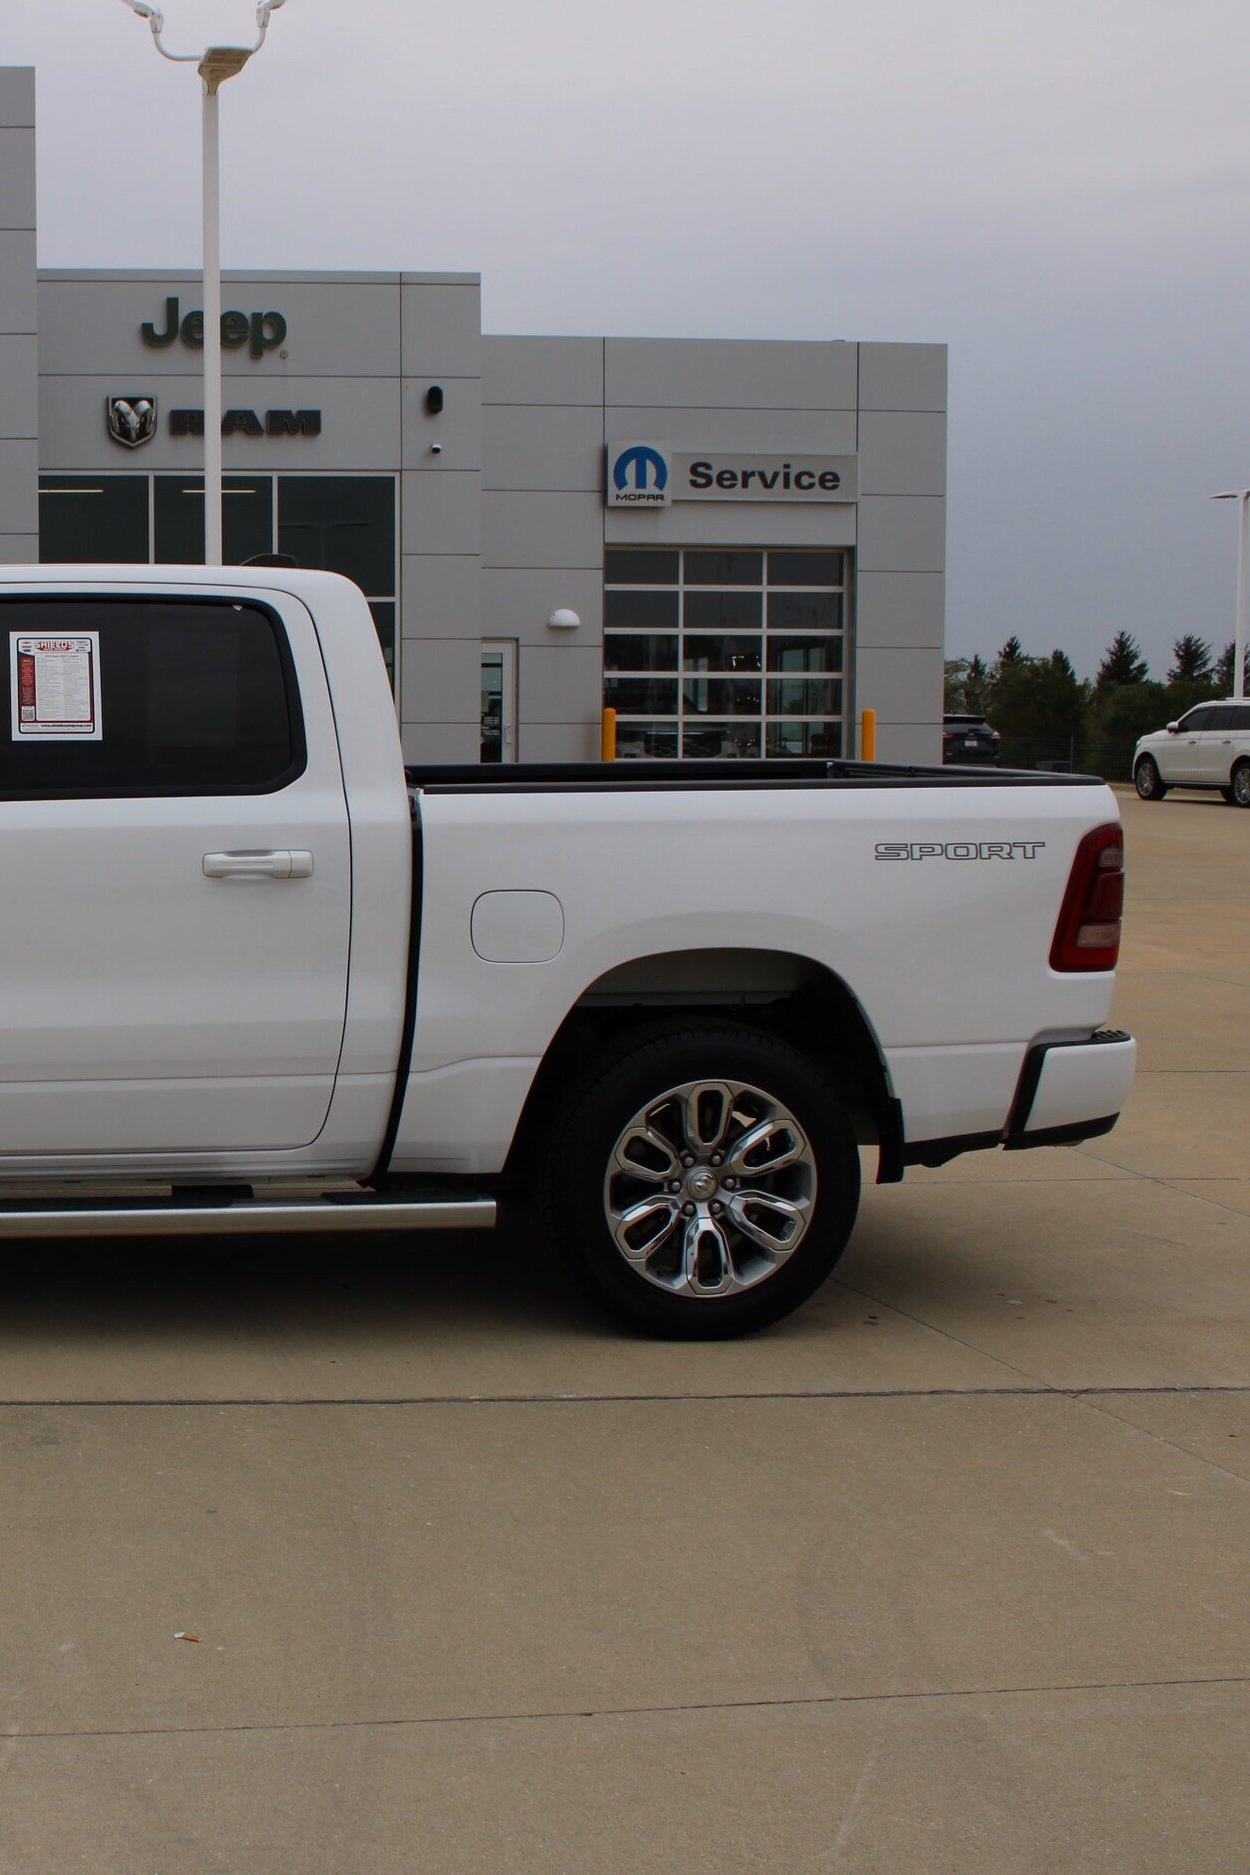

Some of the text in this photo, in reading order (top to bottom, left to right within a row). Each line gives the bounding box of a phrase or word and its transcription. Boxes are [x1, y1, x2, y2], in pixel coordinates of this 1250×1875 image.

[141, 297, 288, 358] Jeep
[169, 410, 322, 436] RAM
[689, 461, 841, 491] Service
[615, 493, 665, 501] MOPAR
[875, 841, 1045, 860] SPORT
